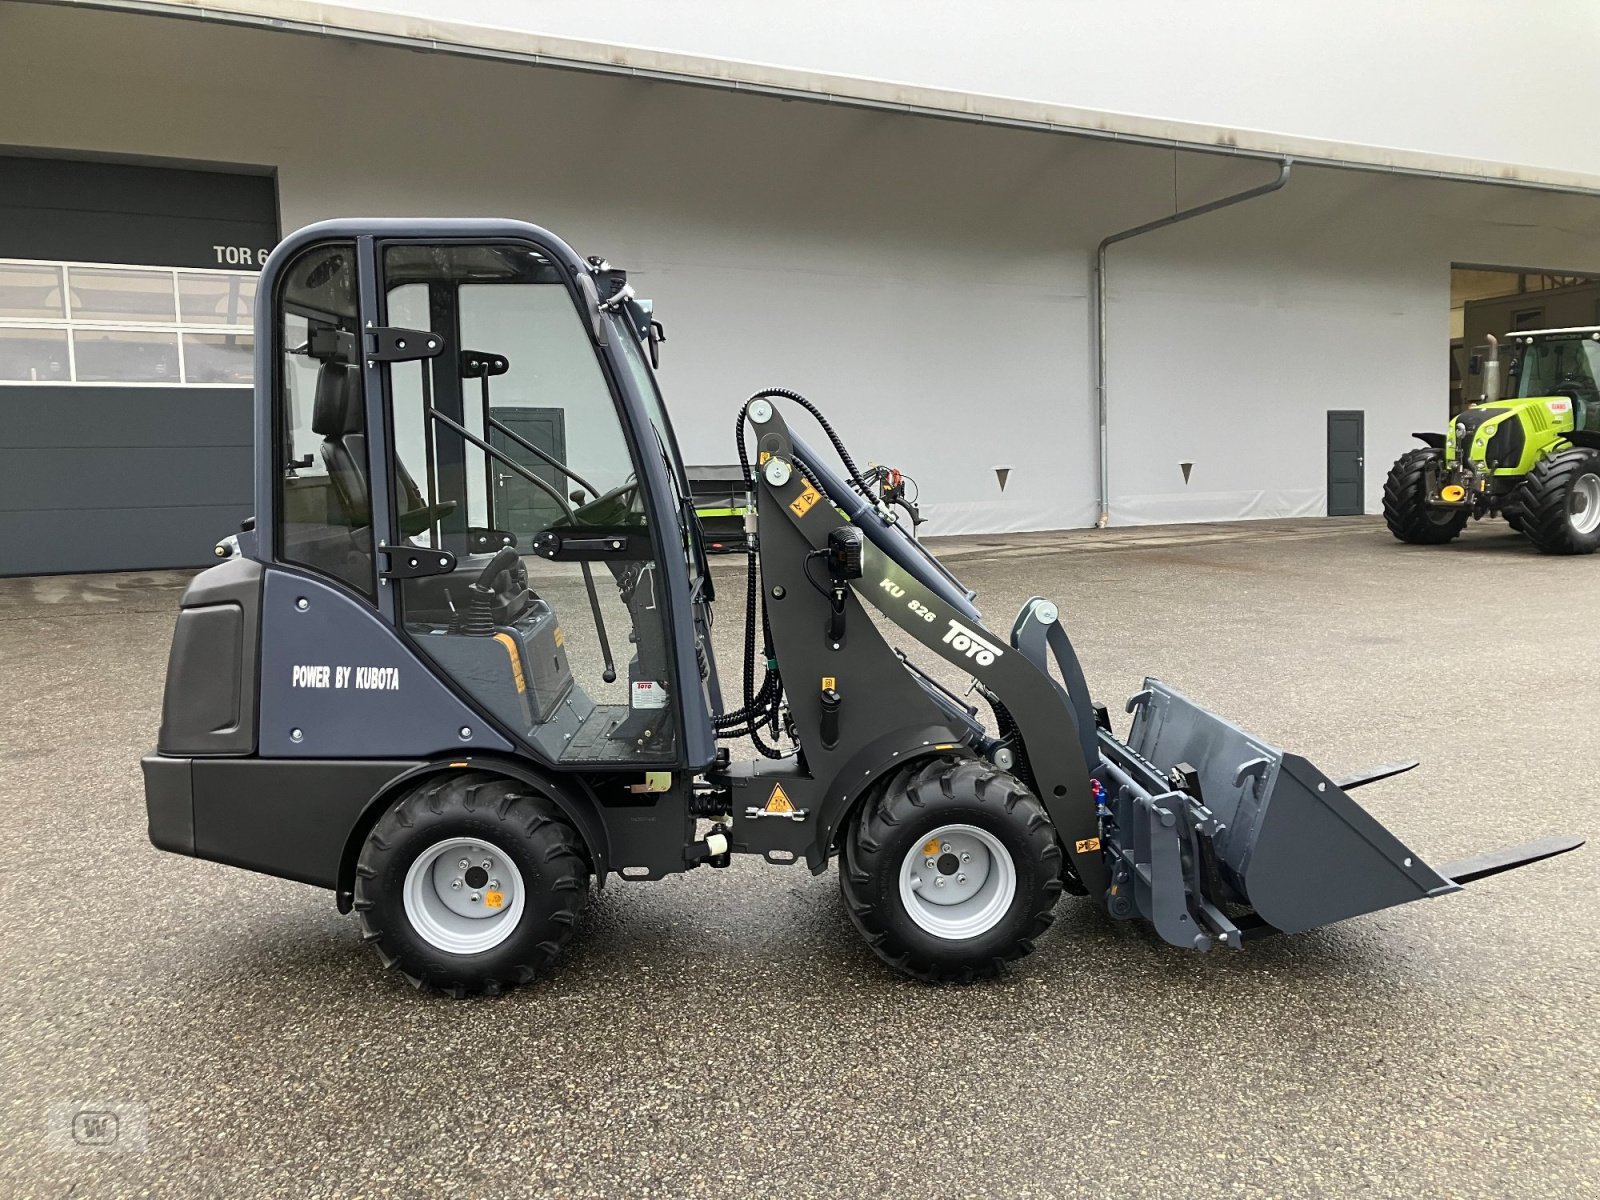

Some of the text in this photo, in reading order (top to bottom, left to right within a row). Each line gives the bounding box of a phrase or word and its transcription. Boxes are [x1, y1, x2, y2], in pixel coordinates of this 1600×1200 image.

[213, 245, 269, 266] TOR 6
[879, 578, 937, 622] KU 826
[941, 618, 1004, 667] TOYO
[292, 665, 400, 690] POWER BY KUBOTA
